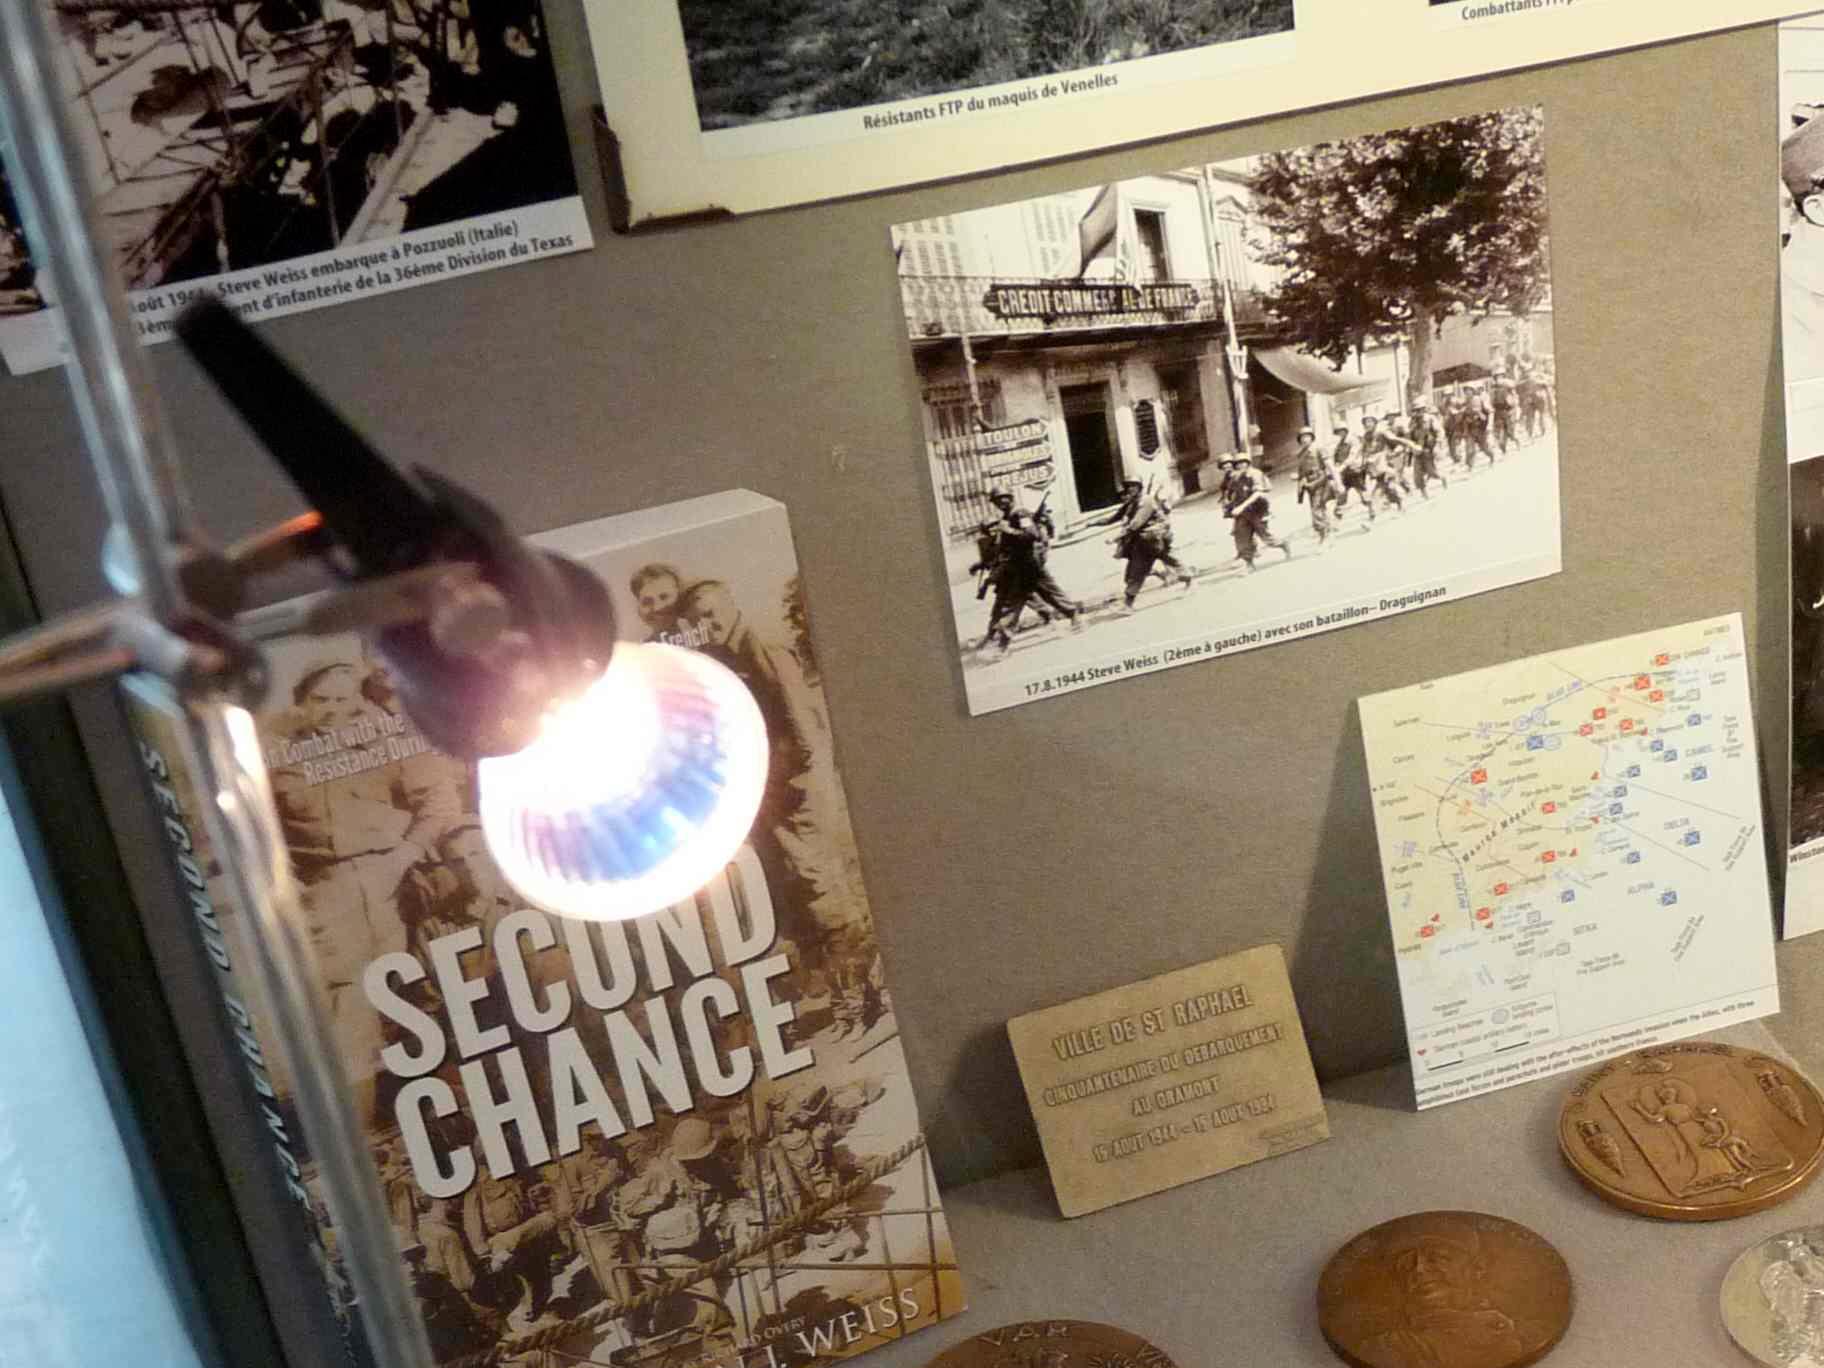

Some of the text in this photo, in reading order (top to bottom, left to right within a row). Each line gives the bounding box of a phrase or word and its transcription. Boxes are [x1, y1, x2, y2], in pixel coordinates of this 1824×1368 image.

[1461, 0, 1543, 20] Combattants
[864, 73, 1119, 129] Résistants FTP du maquis de Venelles
[217, 219, 519, 298] Steve Weiss embarque à Pozzuoli (Italie)
[263, 281, 353, 310] d'infanterie
[355, 273, 374, 289] de
[377, 270, 391, 286] la
[448, 247, 507, 271] Division
[510, 242, 529, 258] du
[530, 233, 574, 254] Texas
[1000, 289, 1052, 315] CREDIT
[984, 423, 1042, 446] TOULON
[1025, 585, 1447, 697] 17.8.1944 Steve Weiss (2ème à gauche) avec son Draguignan
[286, 711, 407, 767] Combat with the
[303, 748, 385, 787] Resistance
[362, 845, 781, 1082] SECOND
[1051, 984, 1254, 1061] VILLE DE ST RAPHAEL
[393, 951, 816, 1199] CHANCE
[1042, 1022, 1283, 1107] CINQUANTENAIRE DU DEBARQUEMENT
[1112, 1132, 1145, 1161] AOUT
[1211, 1104, 1244, 1130] AOUT
[1132, 1097, 1152, 1118] AU
[795, 1287, 921, 1359] WEISS
